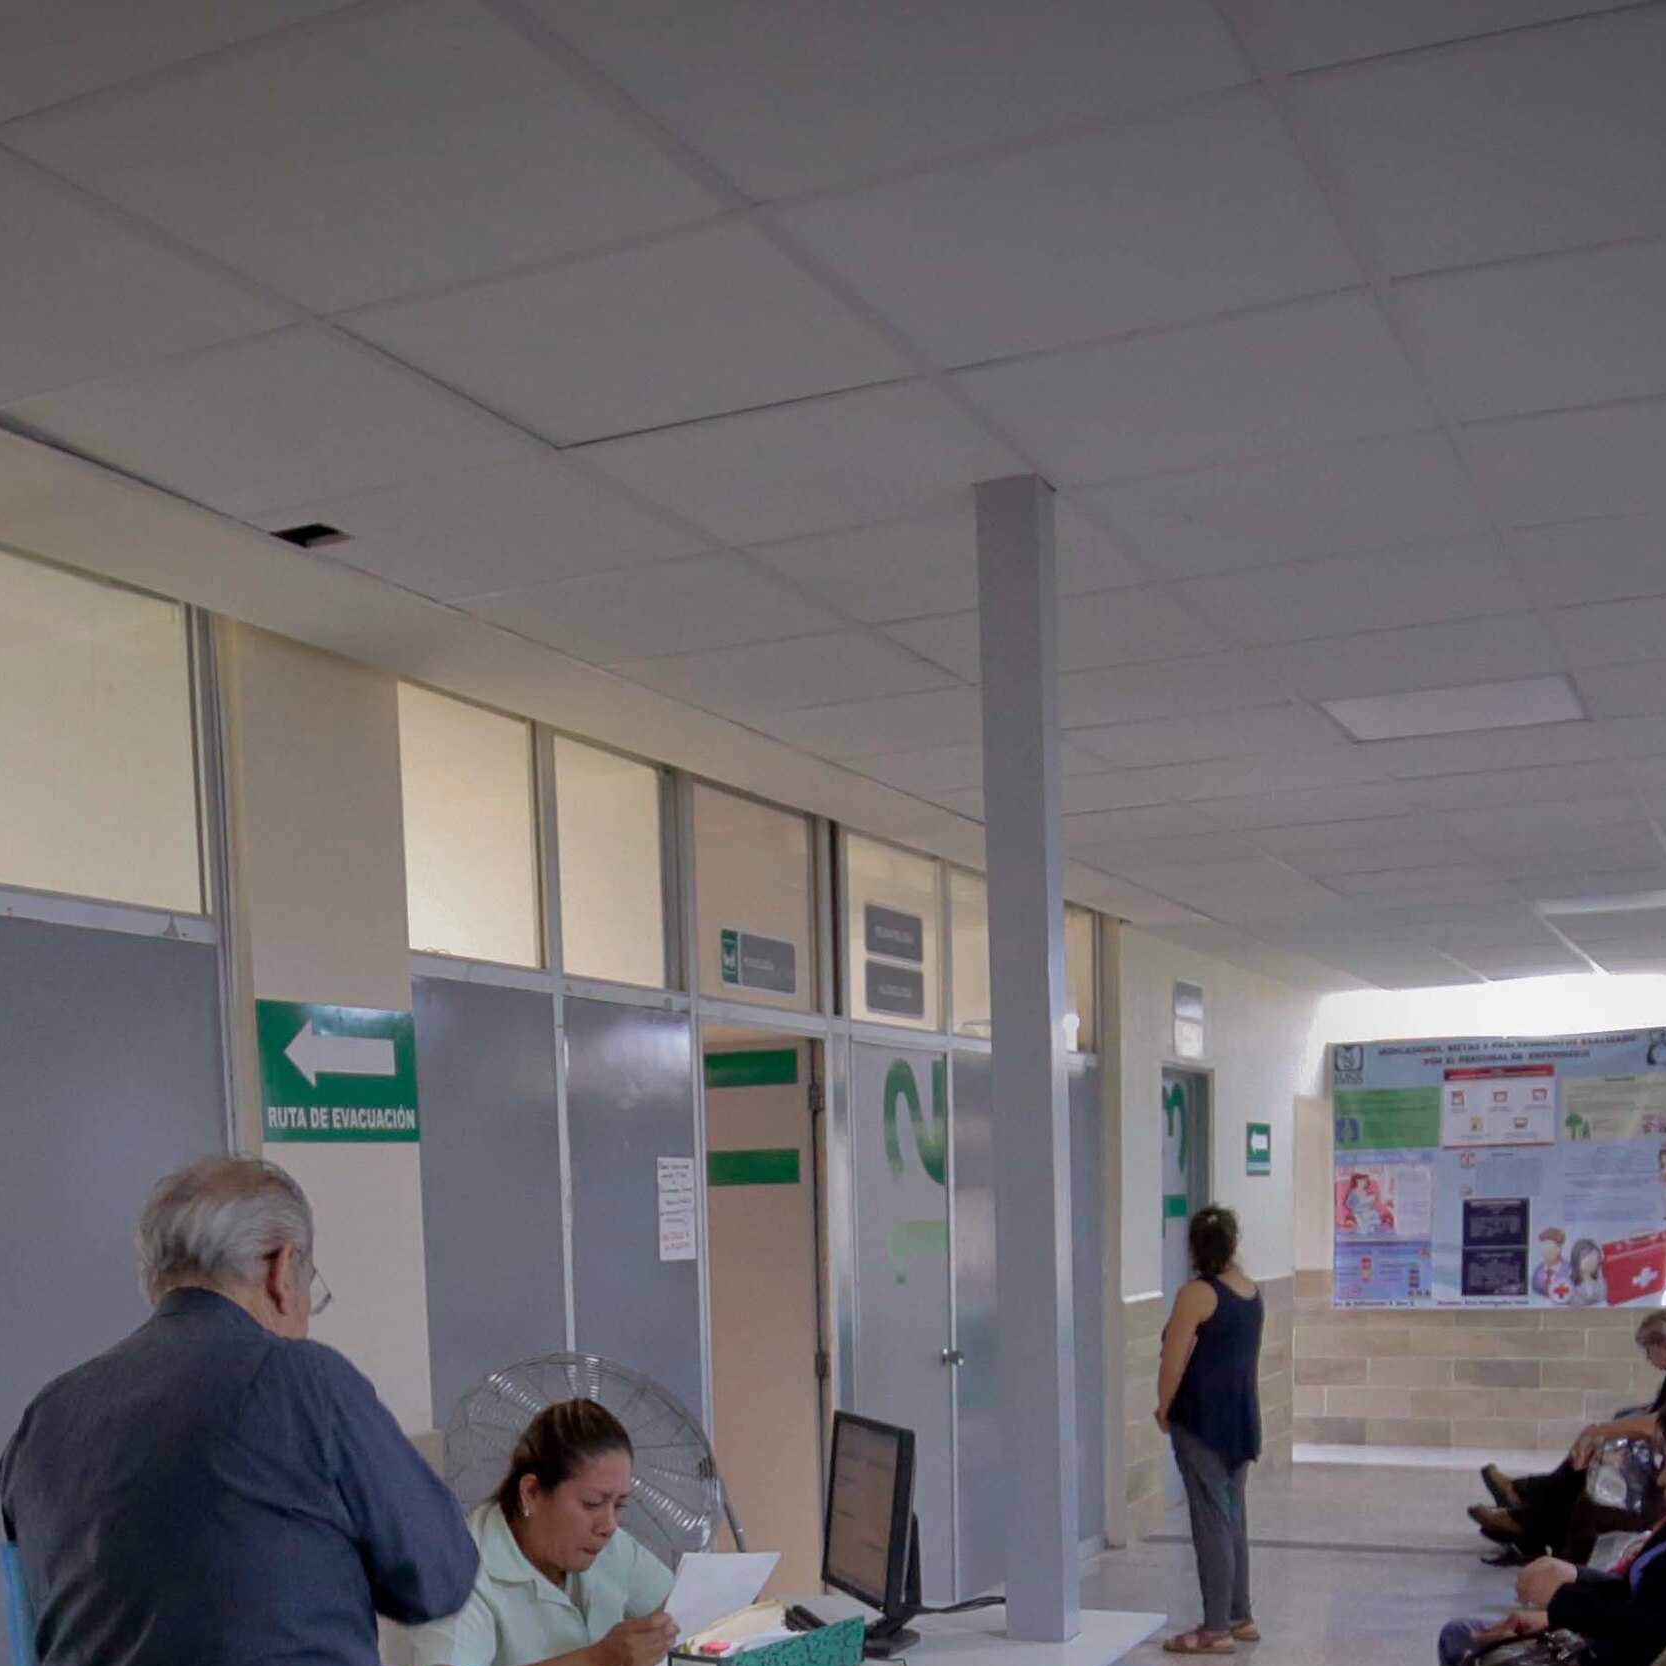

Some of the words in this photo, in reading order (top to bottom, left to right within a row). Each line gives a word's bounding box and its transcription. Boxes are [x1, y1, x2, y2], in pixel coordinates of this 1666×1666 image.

[268, 1106, 307, 1129] RUTA
[310, 1107, 329, 1129] DE
[332, 1104, 416, 1129] EVACUACIÓN
